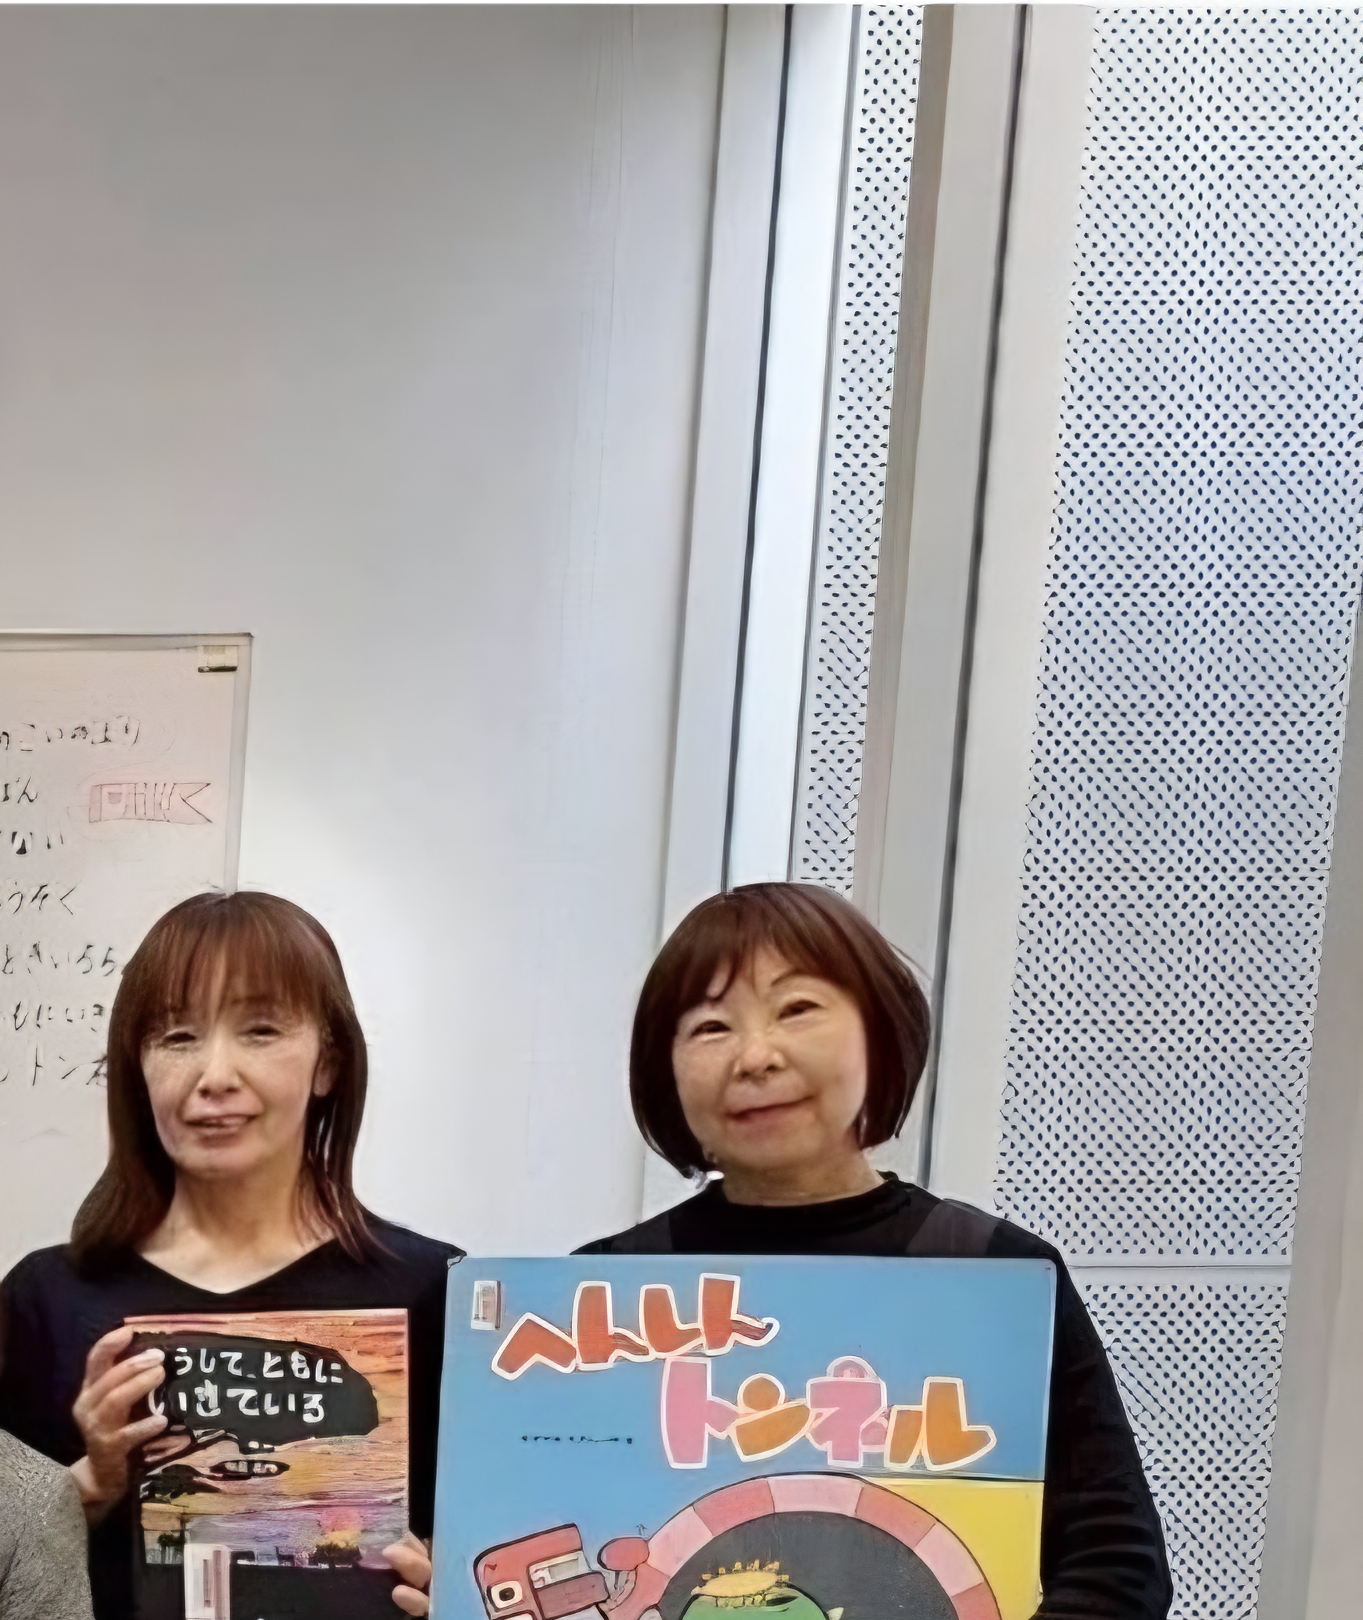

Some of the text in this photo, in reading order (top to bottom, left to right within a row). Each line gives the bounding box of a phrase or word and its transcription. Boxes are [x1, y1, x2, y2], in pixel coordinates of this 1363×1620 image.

[491, 1273, 781, 1381] へんしん
[661, 1355, 996, 1471] トンネル
